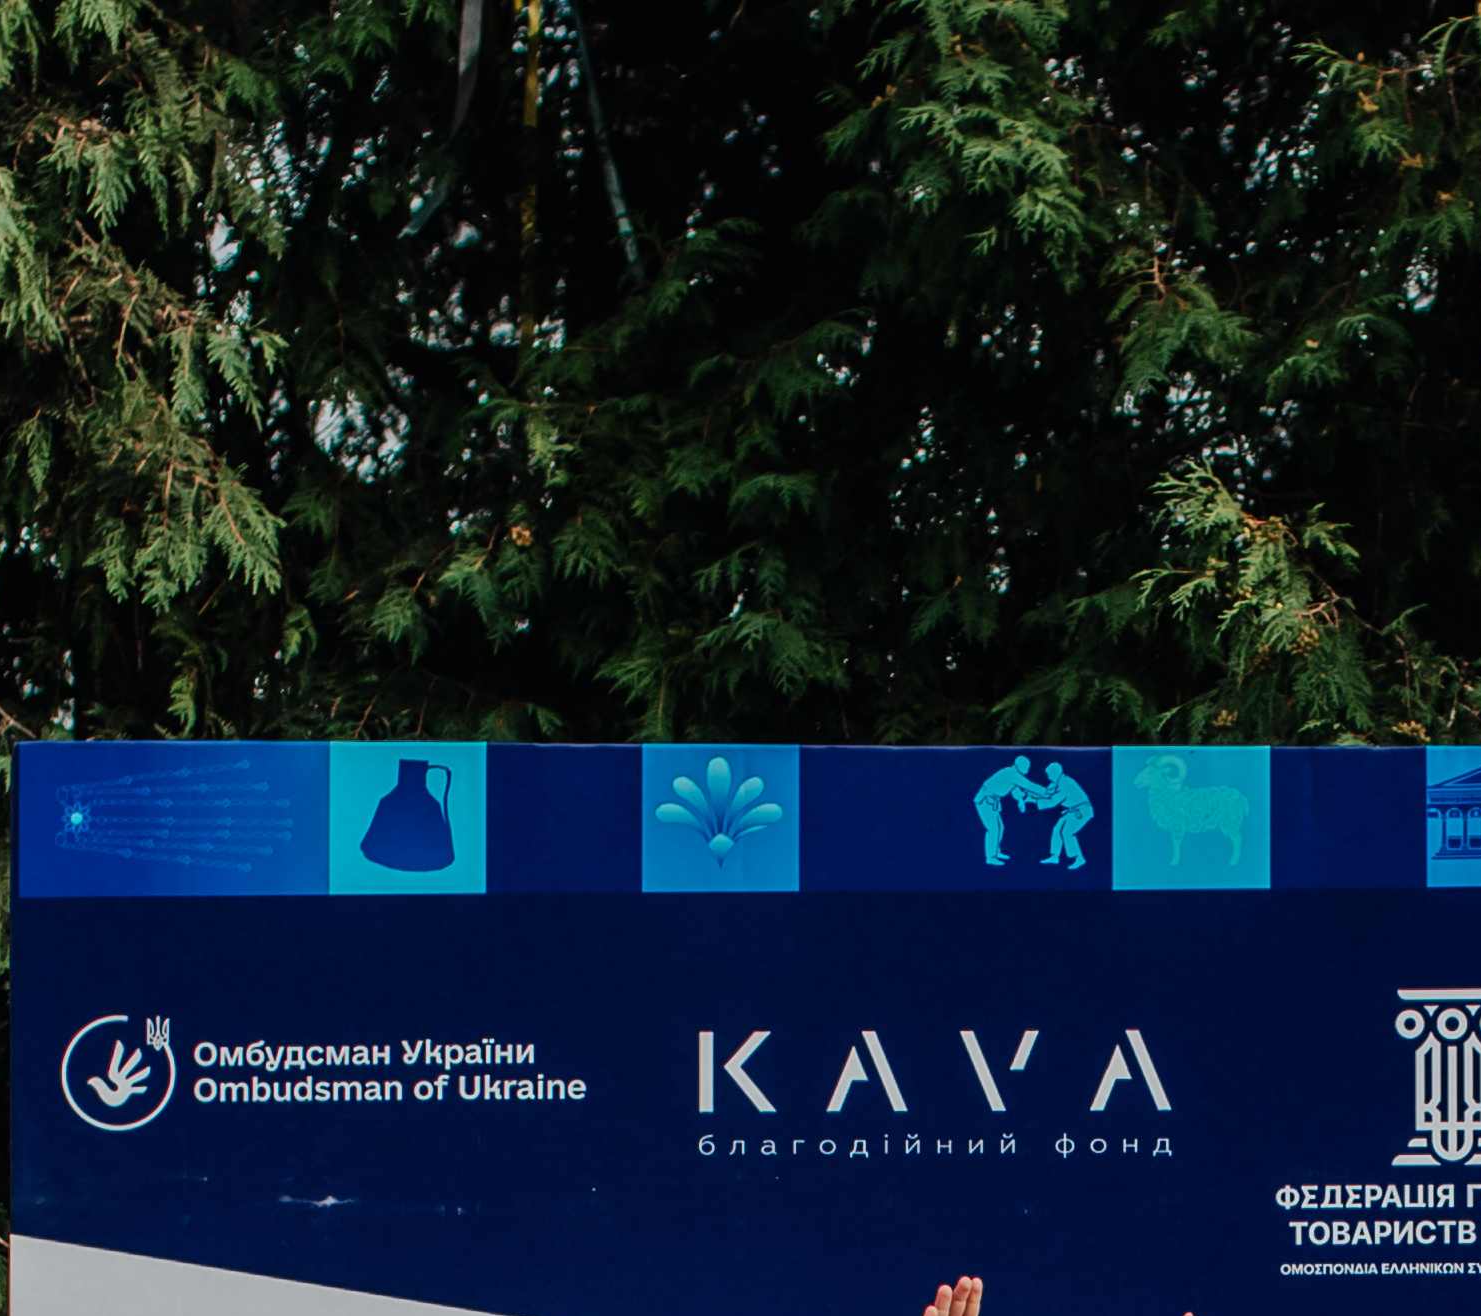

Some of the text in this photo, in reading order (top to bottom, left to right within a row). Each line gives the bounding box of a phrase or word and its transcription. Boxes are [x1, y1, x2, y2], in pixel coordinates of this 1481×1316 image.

[193, 1038, 535, 1072] Омбудсман України
[698, 1028, 1172, 1113] KAVA
[193, 1074, 587, 1102] Ombudsman of Ukraine
[698, 1132, 1173, 1158] благодійний фонд
[1288, 1220, 1477, 1245] ТОВАРИСТВ
